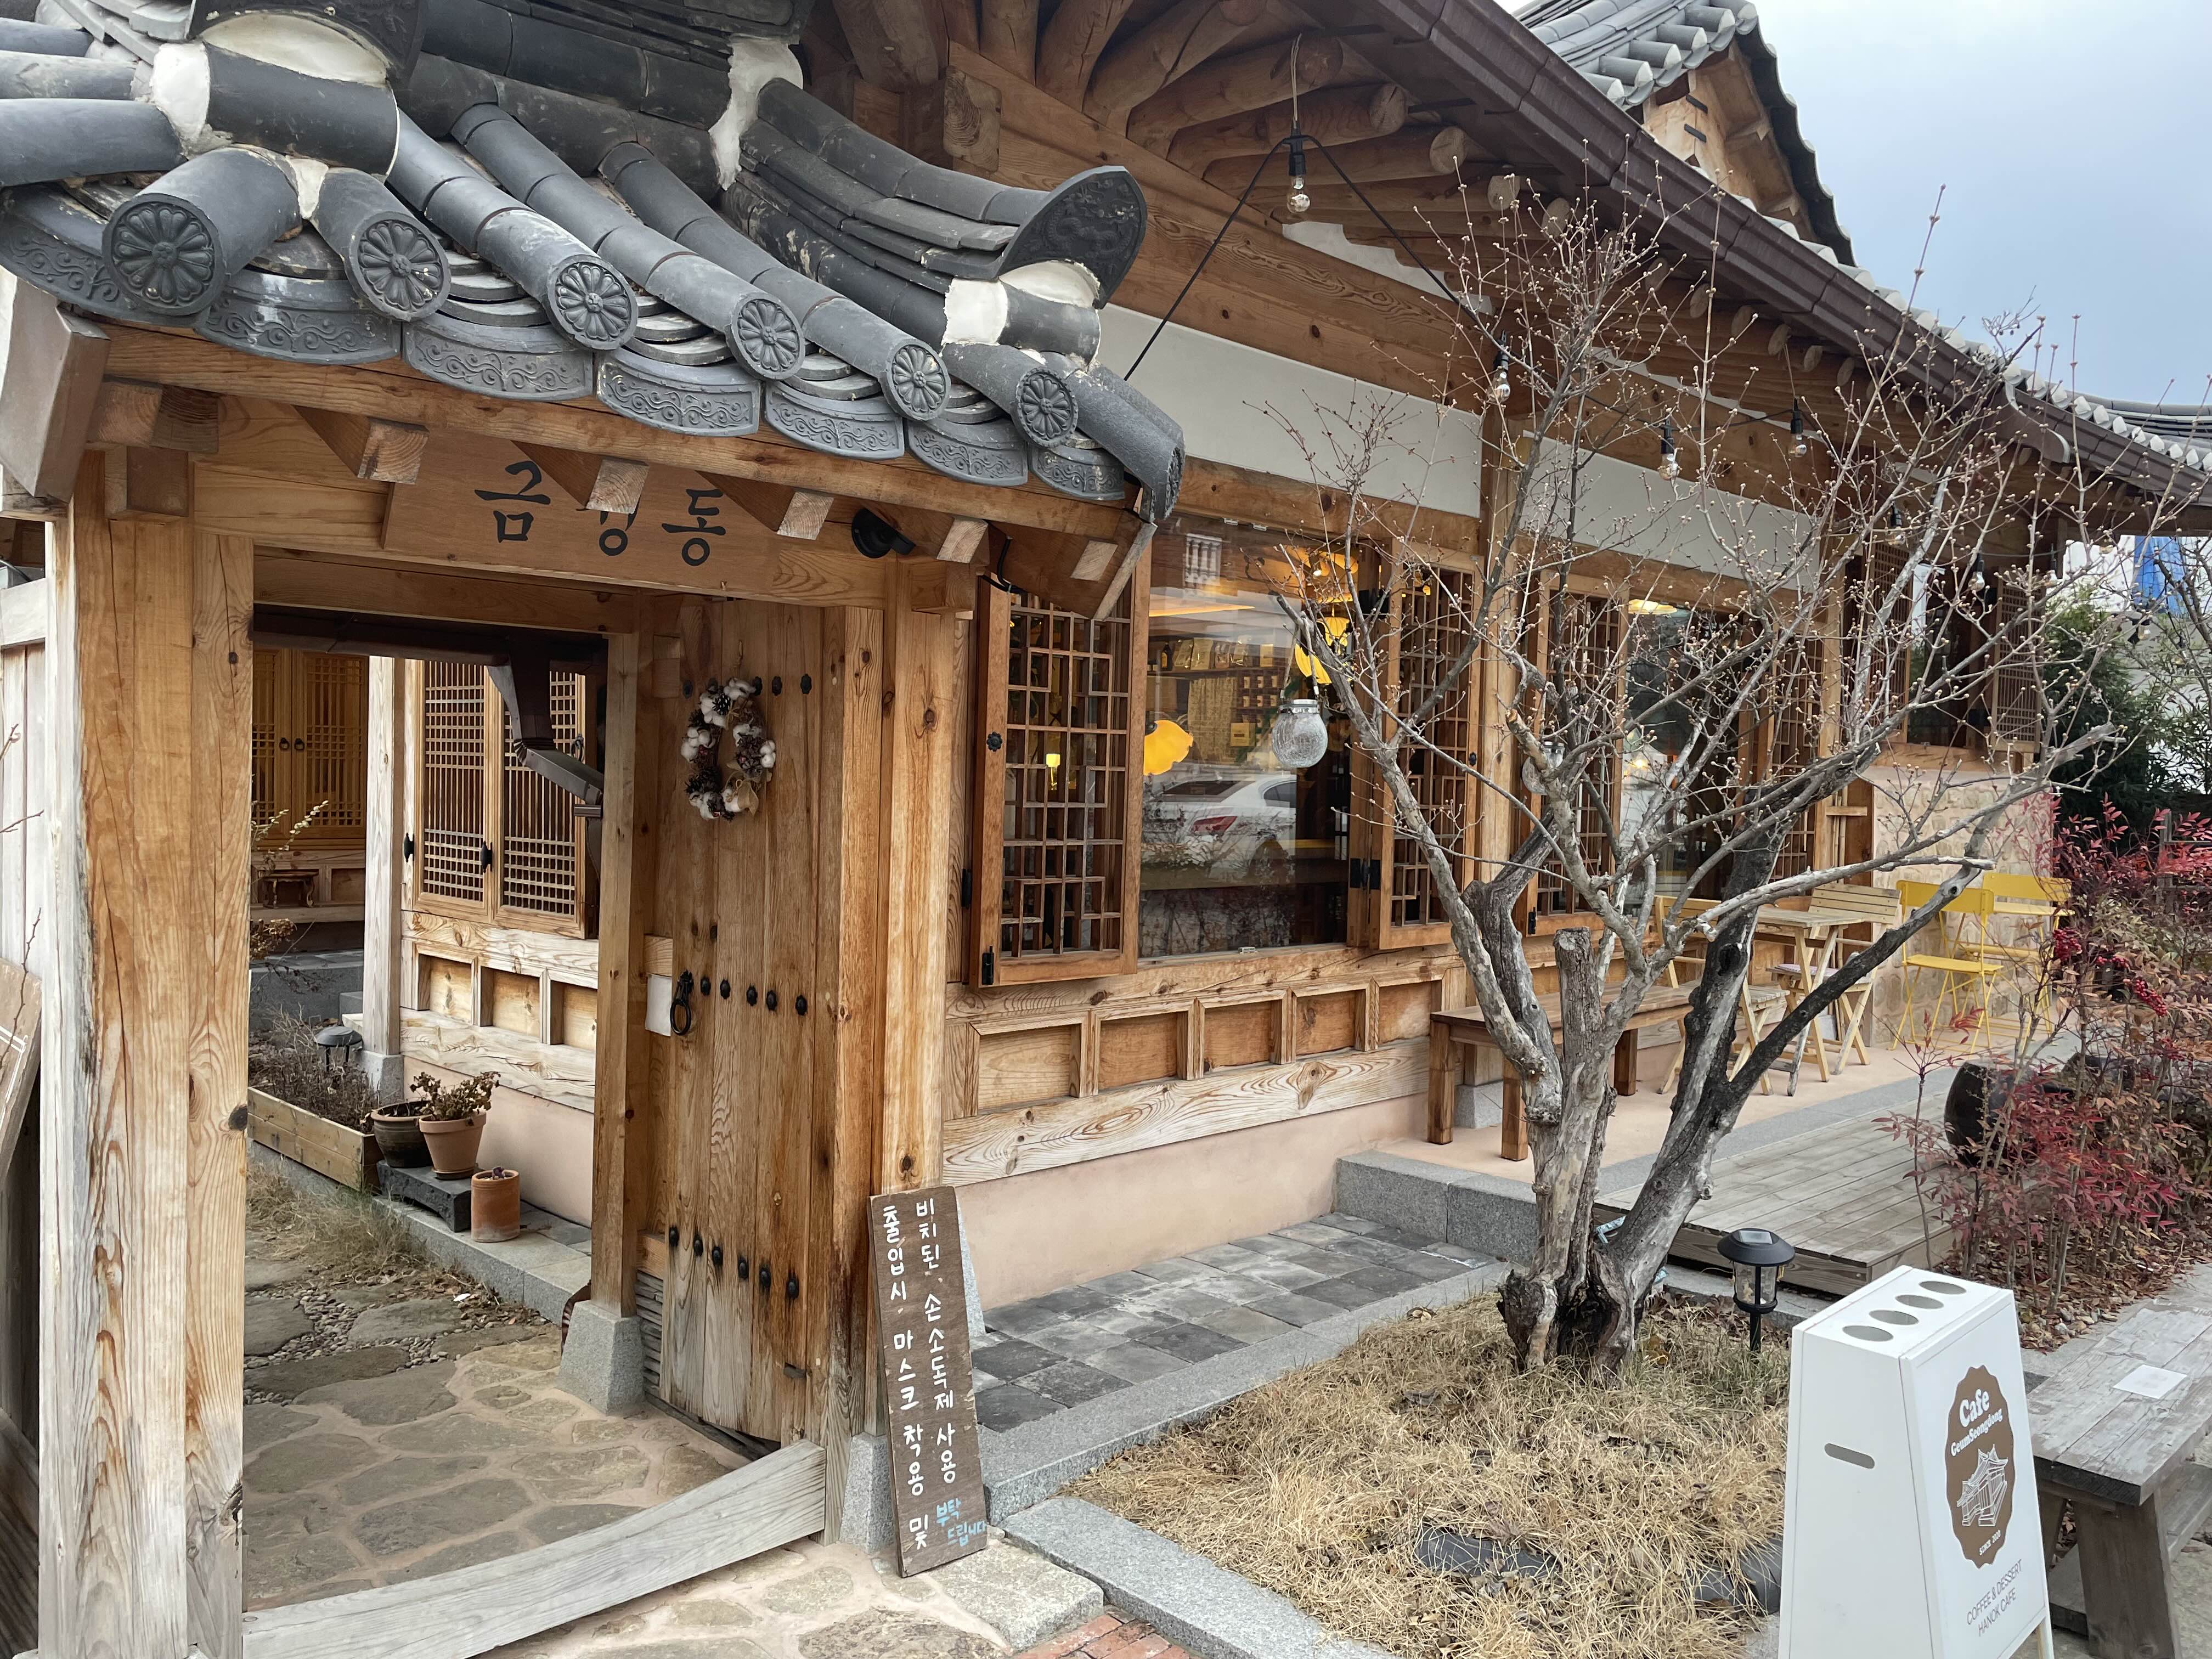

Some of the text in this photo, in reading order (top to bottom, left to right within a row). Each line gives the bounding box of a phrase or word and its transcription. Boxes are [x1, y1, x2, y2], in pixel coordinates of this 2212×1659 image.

[883, 1205, 928, 1550] 출입시 마스크 착용 및
[916, 1198, 987, 1547] 비치된 손소독제 사용 부탁 드립니다
[1959, 1389, 1990, 1427] Cafe
[1967, 1559, 2022, 1625] COFFEE & DESSERT
[1978, 1587, 2016, 1637] HANOK CAFE
